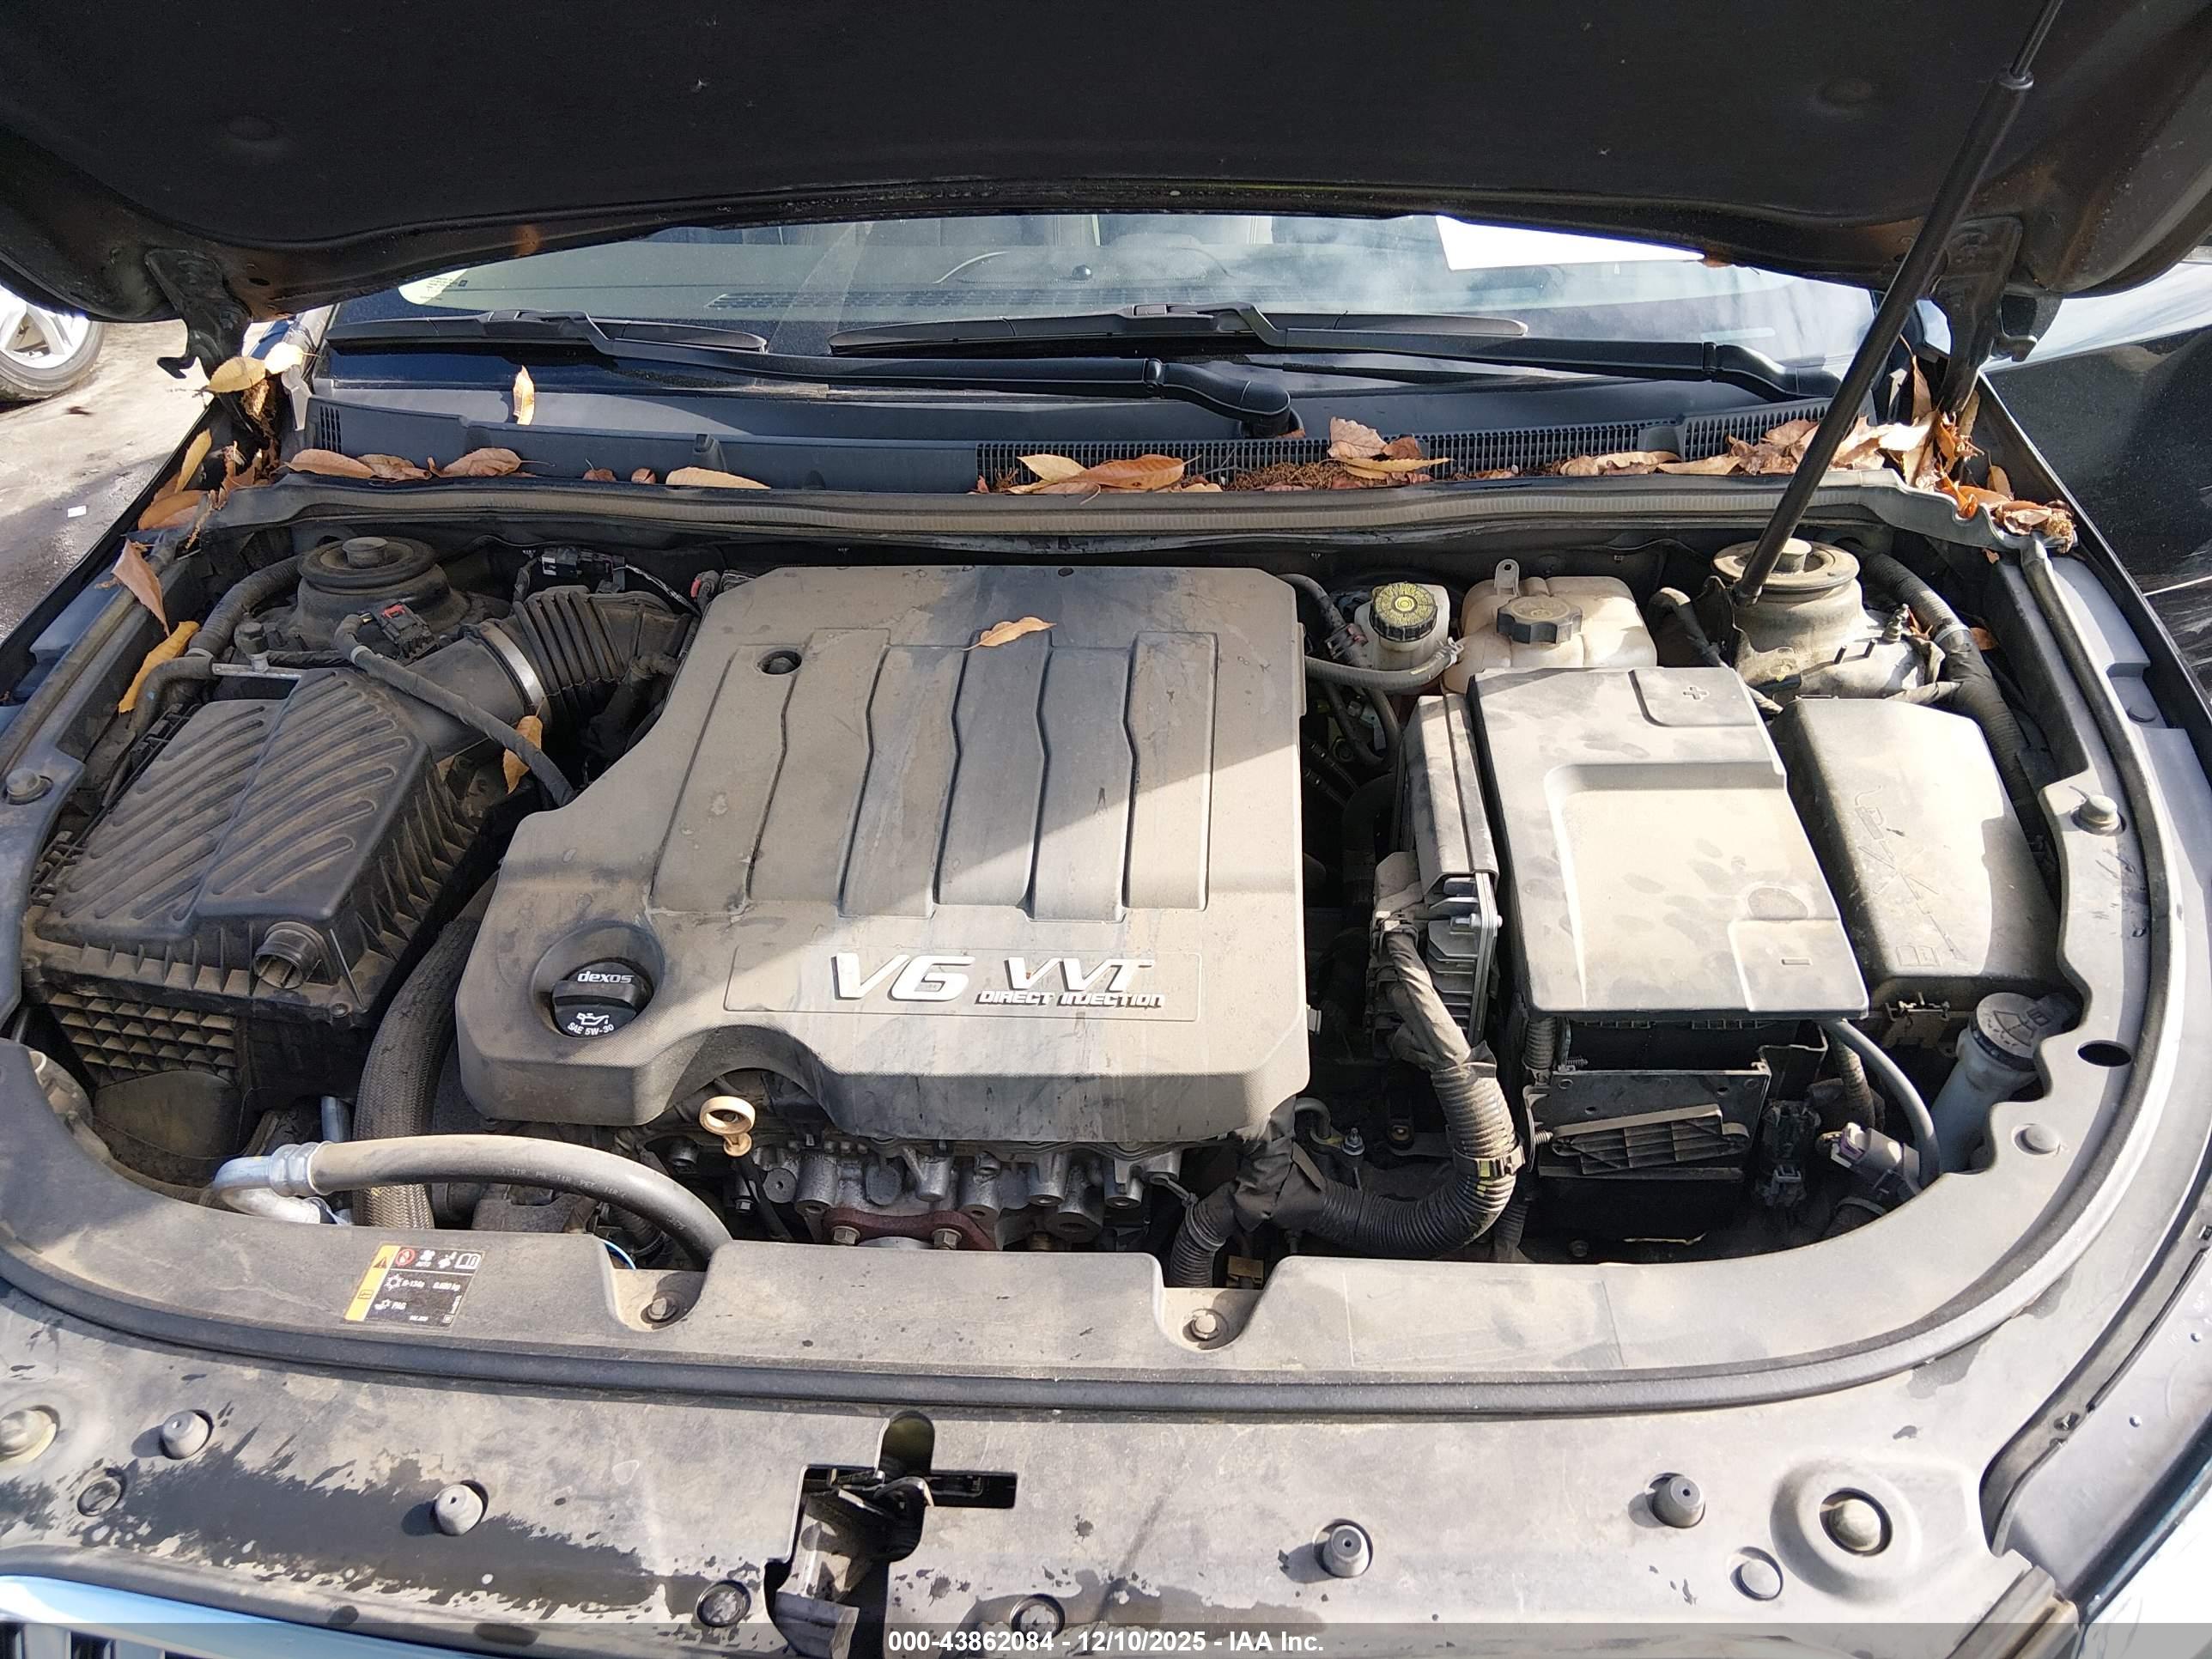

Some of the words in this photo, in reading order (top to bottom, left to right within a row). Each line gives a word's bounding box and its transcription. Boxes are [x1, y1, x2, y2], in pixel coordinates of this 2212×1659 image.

[577, 970, 635, 983] dexos
[831, 952, 975, 1002] V6
[1004, 957, 1156, 993] VVT
[975, 990, 1055, 1006] DIRECT
[1057, 991, 1165, 1009] INJECTION
[568, 1022, 584, 1035] SAE
[585, 1024, 615, 1036] 5W-30
